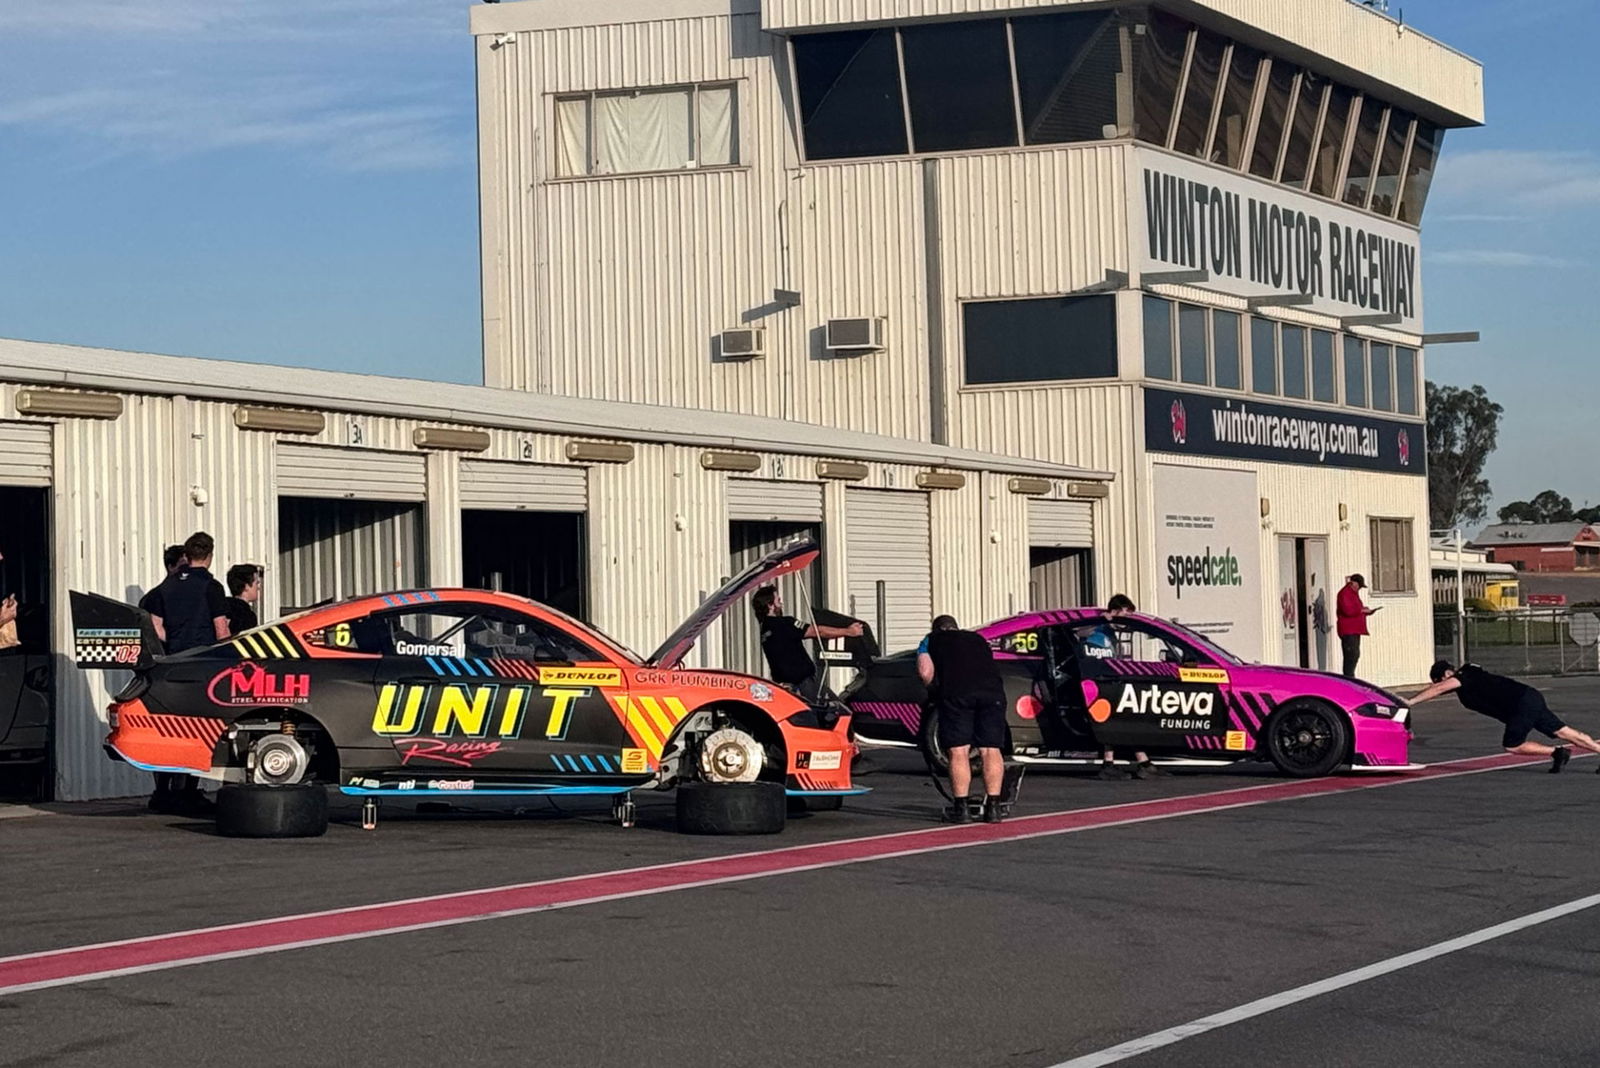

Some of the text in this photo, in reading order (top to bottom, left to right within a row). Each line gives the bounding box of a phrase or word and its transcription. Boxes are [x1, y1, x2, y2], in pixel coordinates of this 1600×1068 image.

[1143, 168, 1416, 319] WINTON MOTOR RACEWAY
[1211, 400, 1380, 462] wintonraceway.com.au
[335, 623, 350, 647] 6
[116, 645, 142, 663] 02
[396, 640, 466, 658] Gomersall
[1084, 644, 1113, 659] Logan
[231, 667, 310, 697] MLH
[555, 672, 618, 681] DUNLOP
[634, 671, 748, 691] GRK PLUMBING
[1189, 671, 1226, 679] DUNLOP
[1116, 683, 1214, 715] Arteva
[371, 682, 594, 742] UNIT
[1160, 718, 1211, 730] FUNDING
[394, 737, 504, 768] Racing
